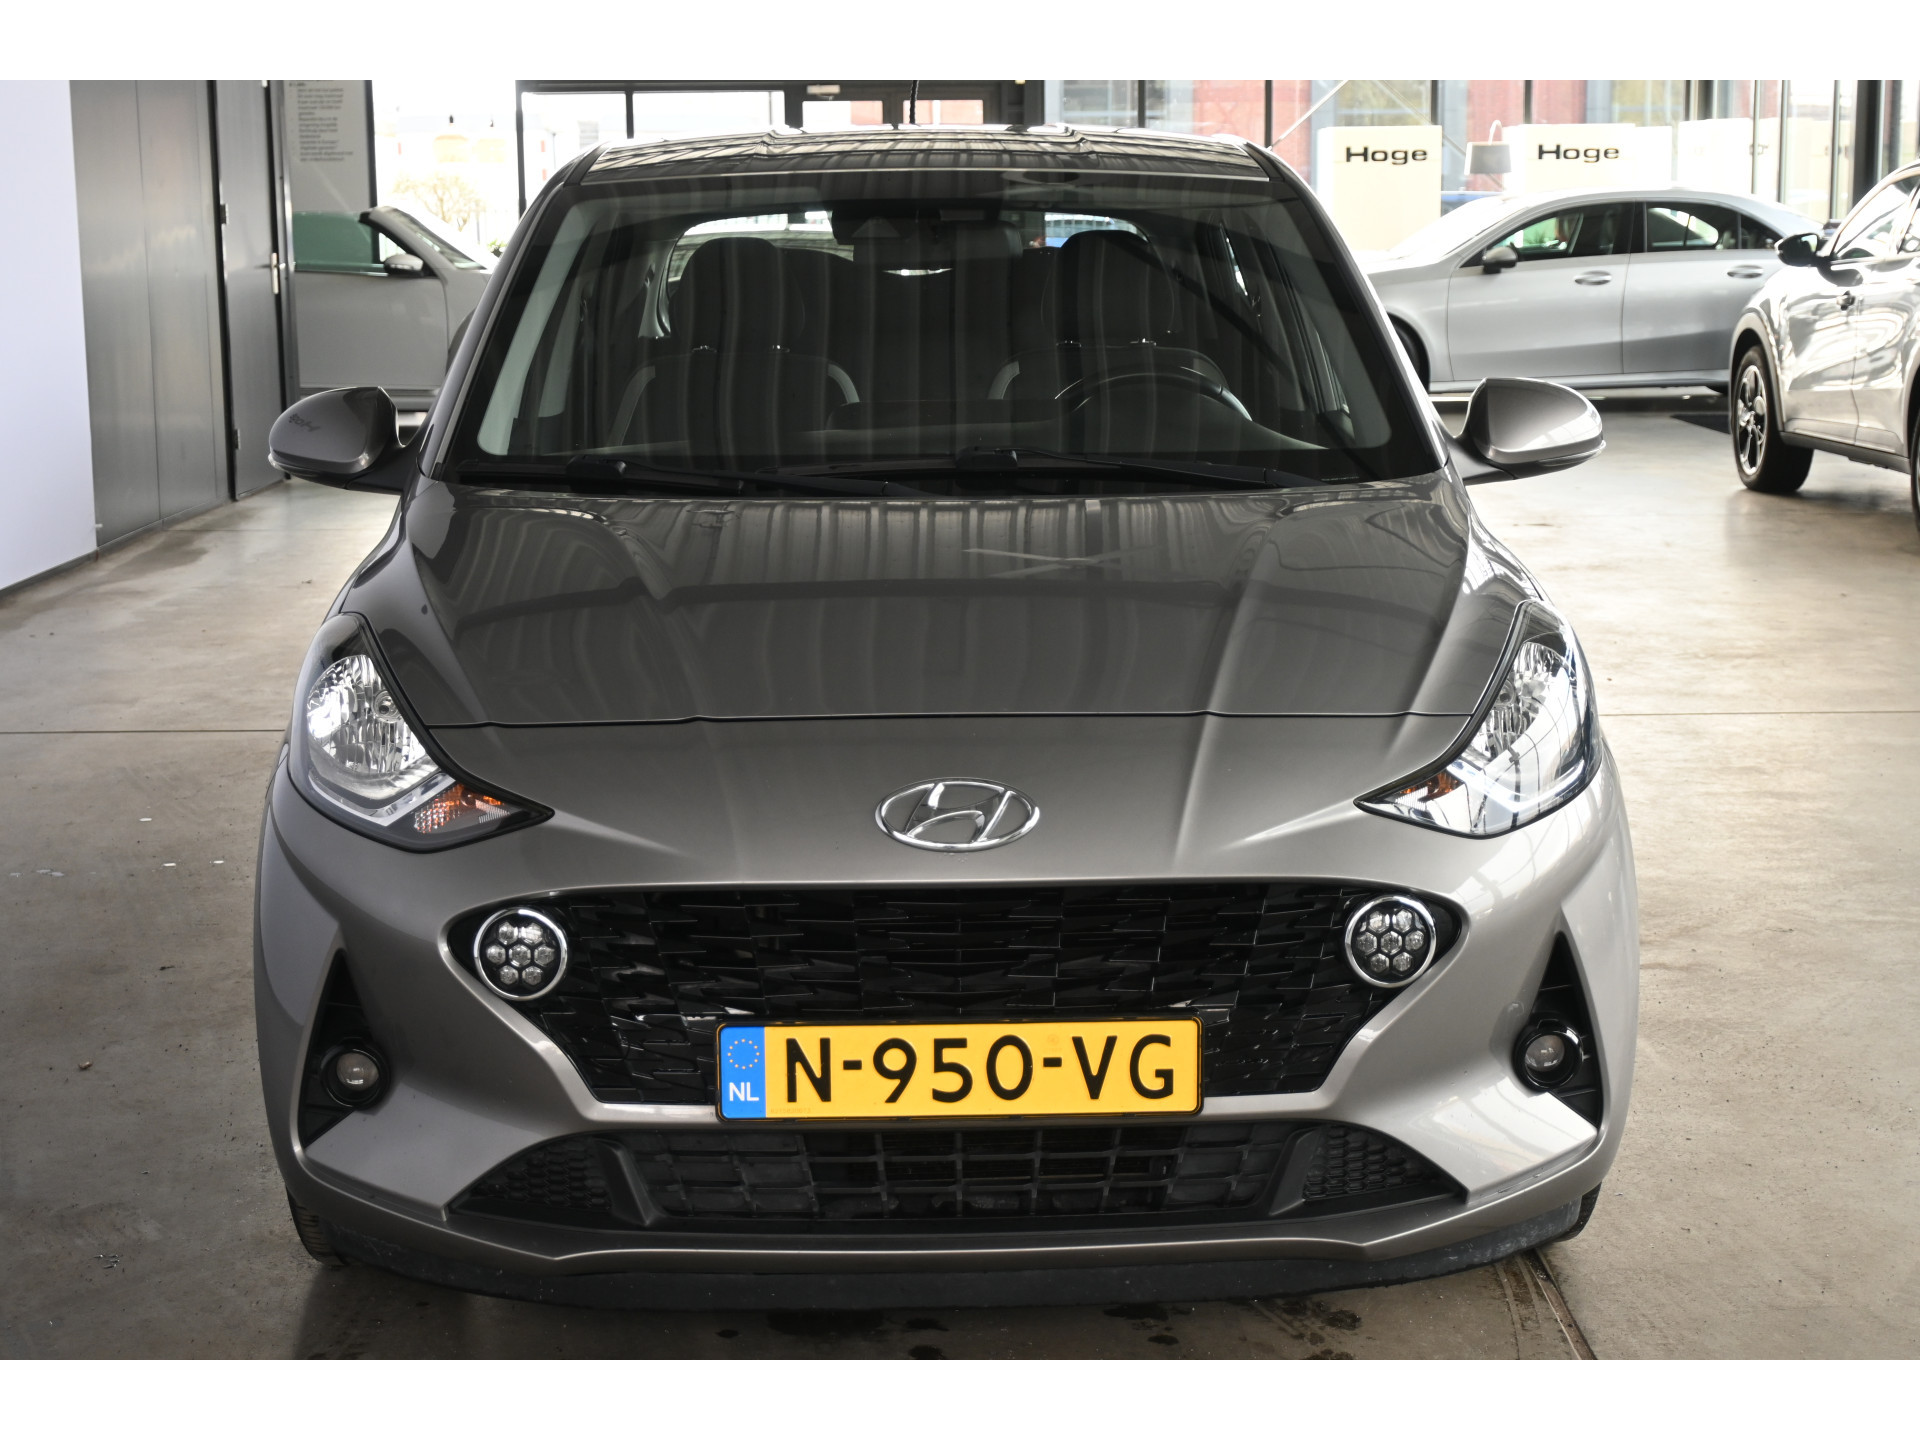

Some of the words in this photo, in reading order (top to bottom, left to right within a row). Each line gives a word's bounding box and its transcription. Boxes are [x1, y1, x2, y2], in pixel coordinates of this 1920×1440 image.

[1346, 146, 1427, 165] Hoge
[1538, 144, 1619, 163] Hoge
[785, 1034, 1175, 1103] N-950-VG
[729, 1082, 759, 1101] NL
